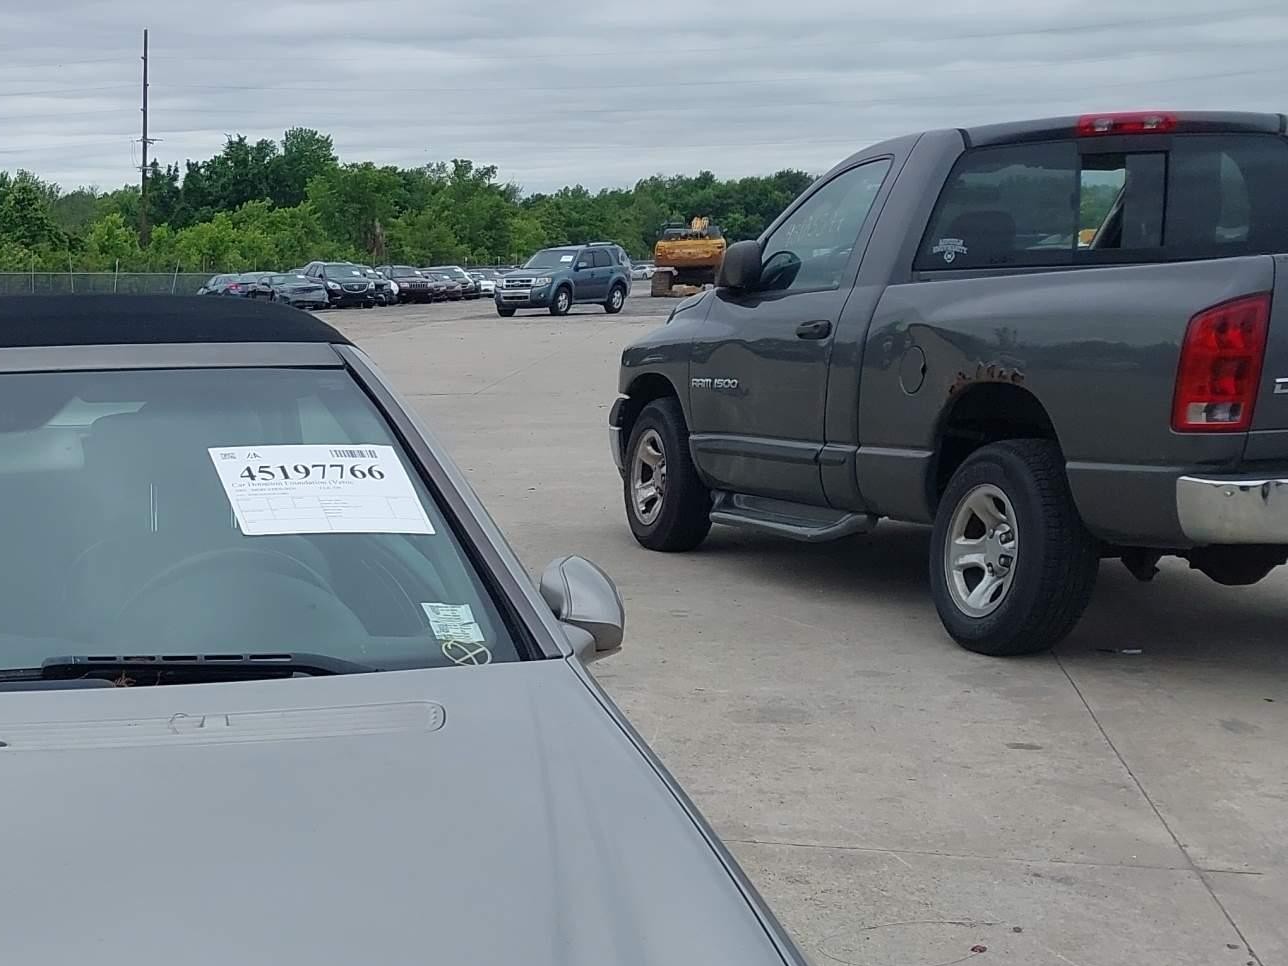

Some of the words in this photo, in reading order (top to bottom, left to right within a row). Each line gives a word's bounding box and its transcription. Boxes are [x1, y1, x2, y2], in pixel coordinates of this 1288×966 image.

[691, 377, 712, 389] RAM
[713, 377, 739, 389] 1500
[239, 463, 386, 482] 45197766
